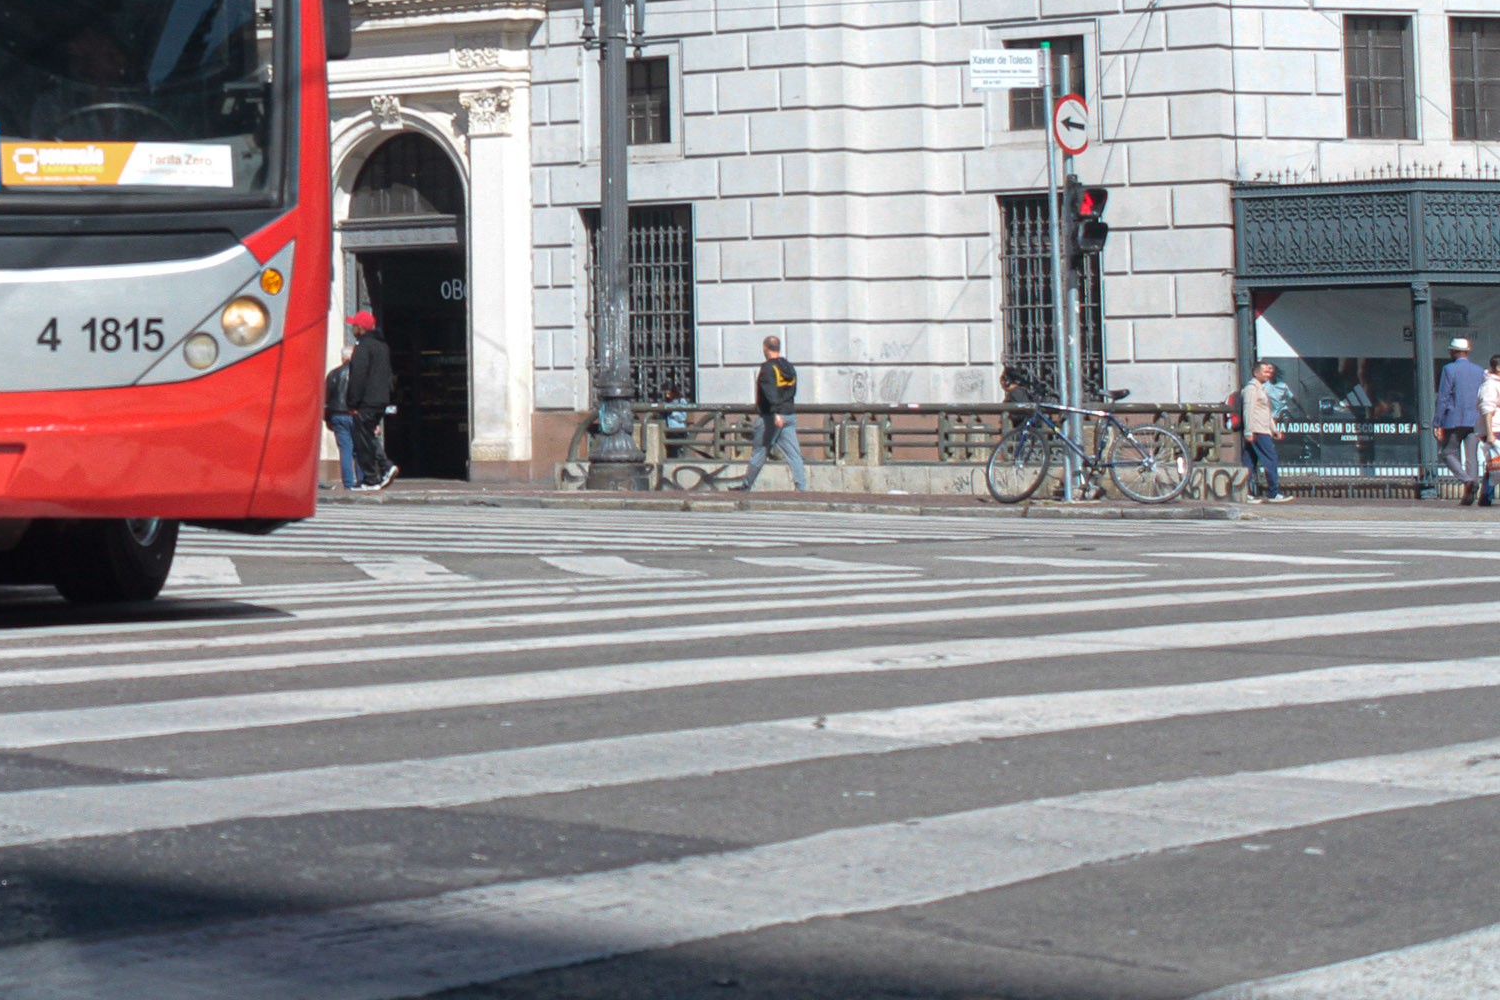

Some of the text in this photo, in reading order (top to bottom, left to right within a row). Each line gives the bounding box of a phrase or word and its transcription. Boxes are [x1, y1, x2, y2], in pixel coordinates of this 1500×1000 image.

[972, 55, 1033, 65] Xavier de Toledo
[37, 317, 164, 353] 4 1815
[1287, 422, 1320, 433] ADIDAS
[1322, 422, 1343, 434] COM
[1345, 422, 1396, 434] DESCONTOS
[1398, 423, 1410, 434] DE
